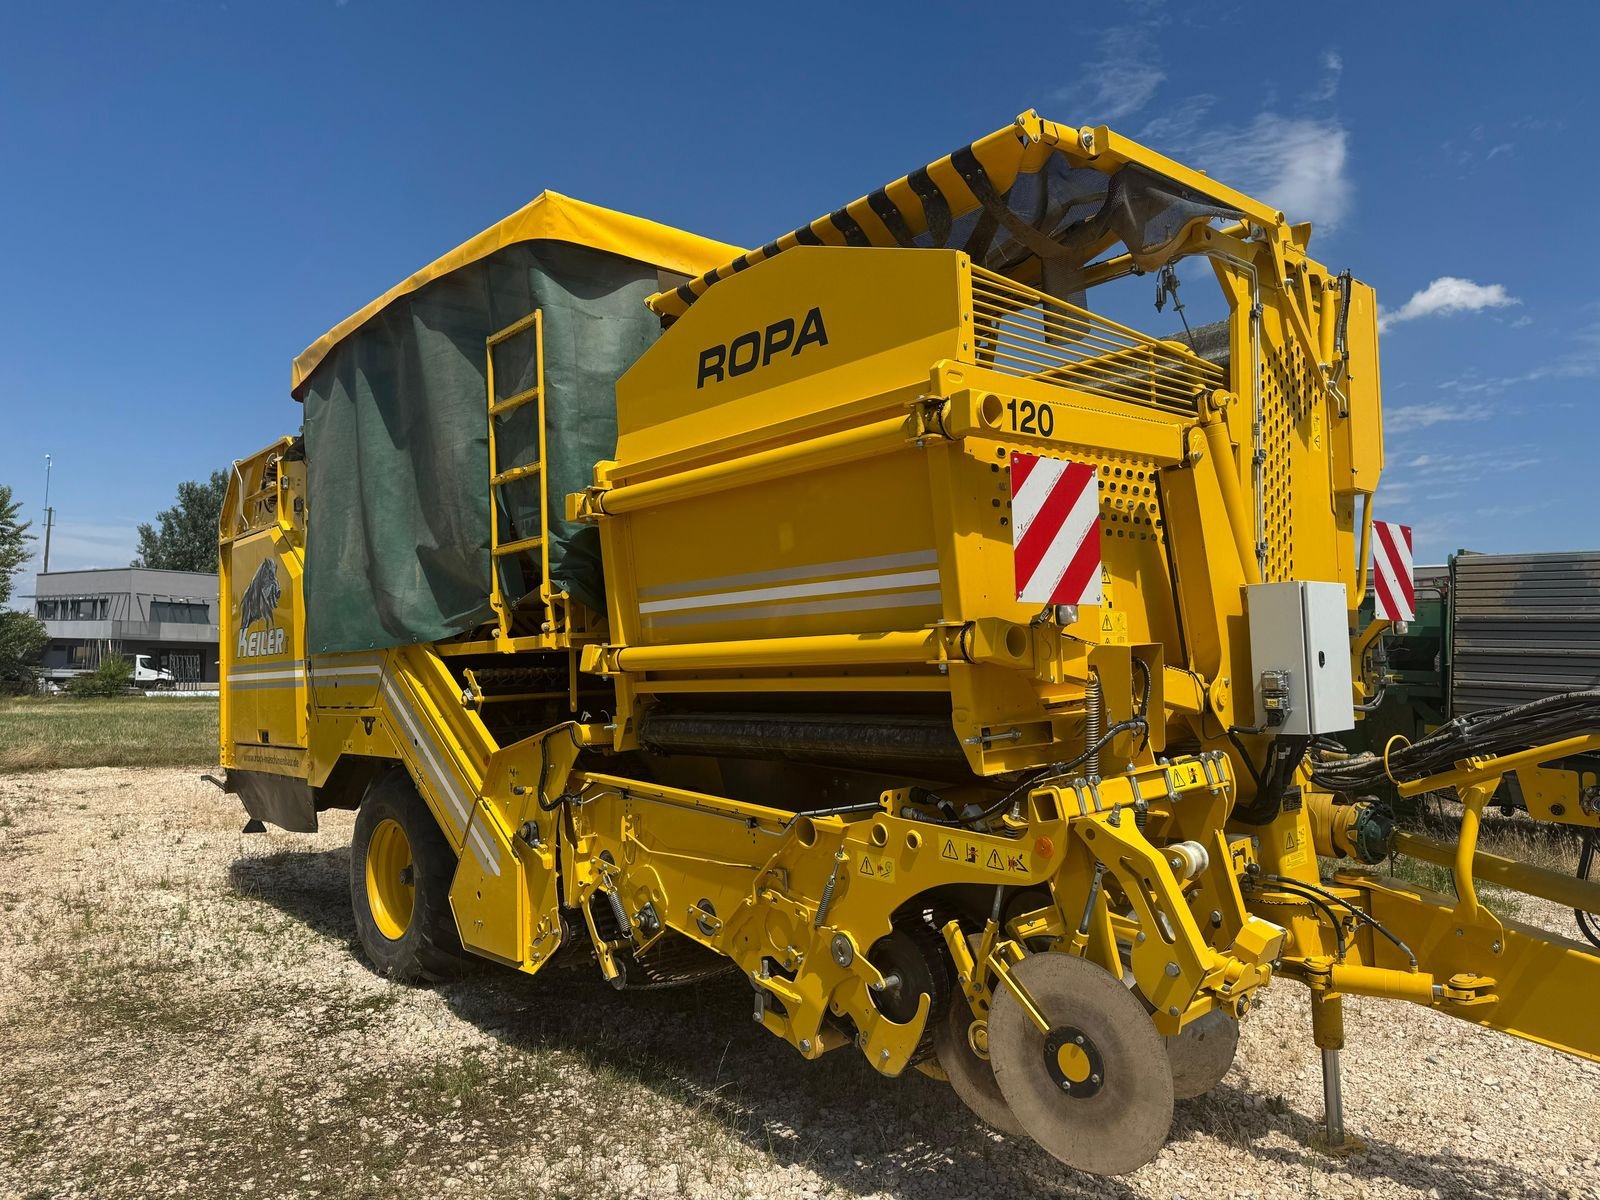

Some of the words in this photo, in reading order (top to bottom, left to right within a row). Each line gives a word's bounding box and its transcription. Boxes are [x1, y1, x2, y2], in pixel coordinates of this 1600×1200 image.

[697, 307, 828, 389] ROPA
[1007, 398, 1054, 437] 120
[237, 627, 284, 658] KEILER
